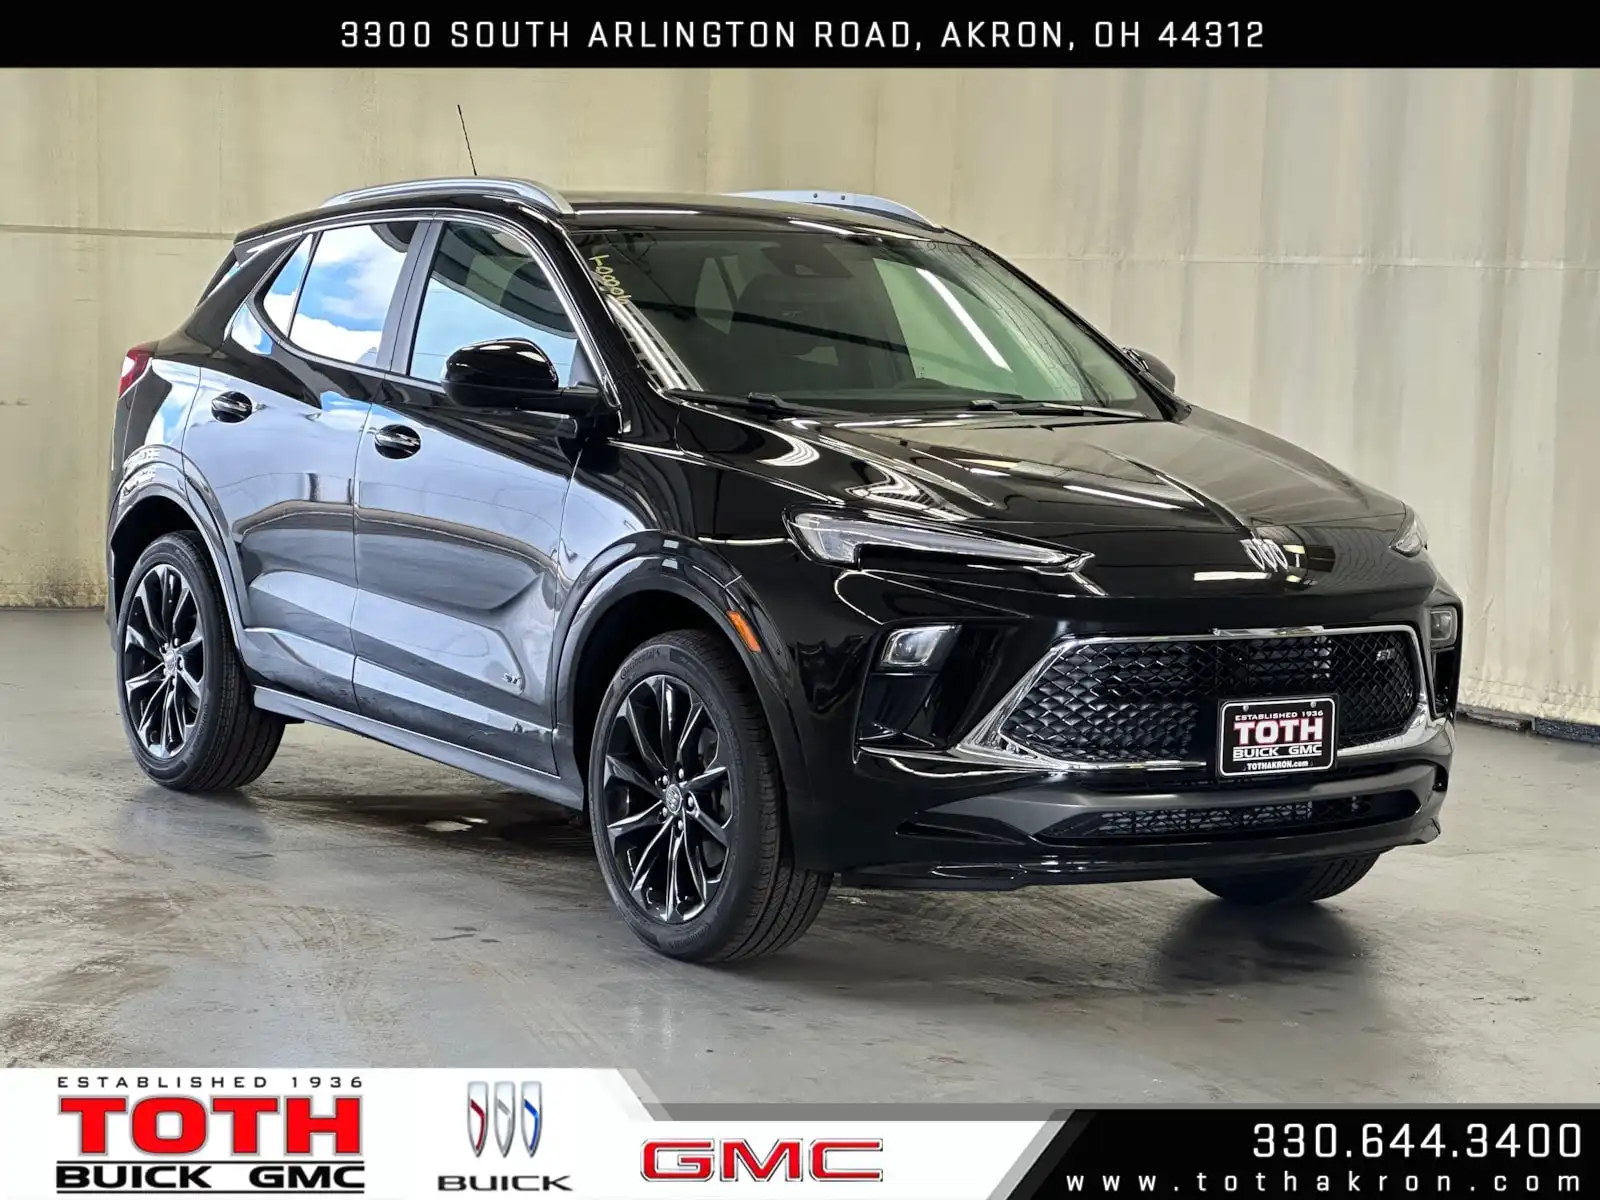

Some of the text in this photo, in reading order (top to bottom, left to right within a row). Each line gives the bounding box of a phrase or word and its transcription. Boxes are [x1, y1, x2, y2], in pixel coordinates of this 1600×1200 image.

[1235, 709, 1324, 721] ESTABLISHED 1936
[1233, 717, 1323, 745] TOTH
[1233, 744, 1322, 759] BUICK GMC
[1247, 760, 1309, 771] TOTHAKRON.com
